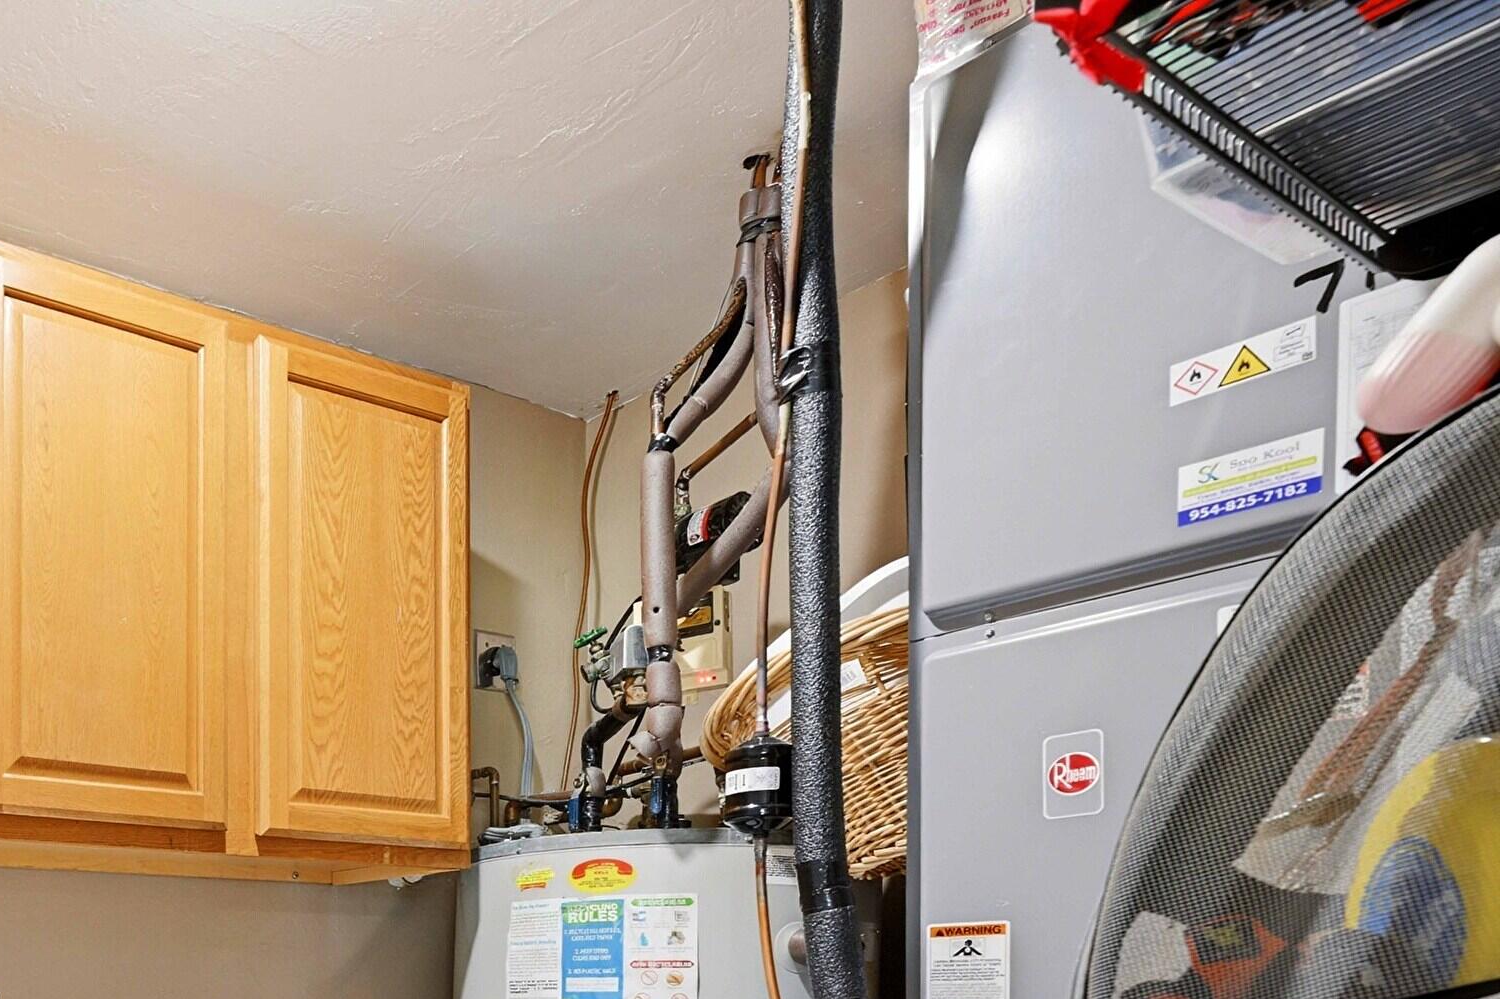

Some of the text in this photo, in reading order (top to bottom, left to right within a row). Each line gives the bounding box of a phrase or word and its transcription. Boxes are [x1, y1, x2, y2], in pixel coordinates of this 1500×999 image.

[1188, 482, 1308, 522] 954-825-7182
[567, 911, 618, 924] RULES
[944, 924, 1002, 937] WARNING
